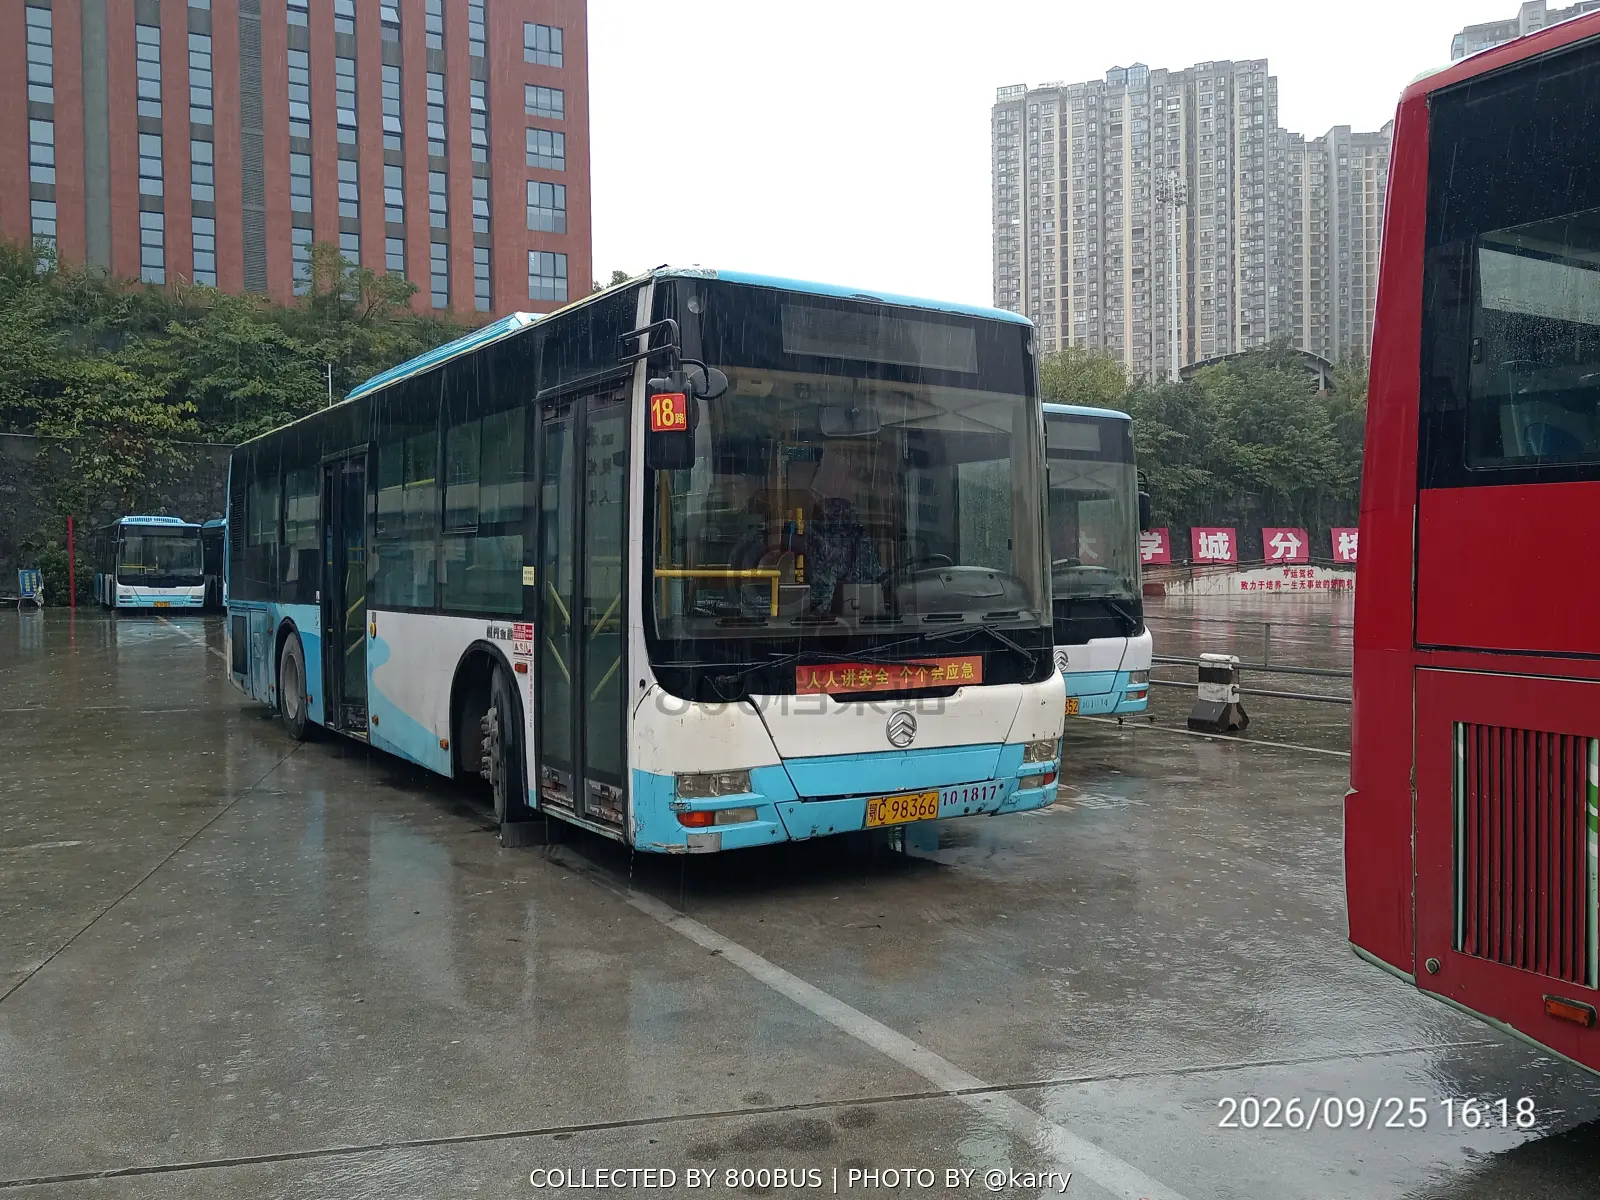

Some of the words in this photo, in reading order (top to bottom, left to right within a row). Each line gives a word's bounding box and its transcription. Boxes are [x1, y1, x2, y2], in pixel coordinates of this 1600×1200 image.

[652, 398, 685, 427] 18路
[806, 667, 889, 689] 人人讲安全
[900, 661, 974, 684] 个个会应急
[942, 785, 997, 806] 101817
